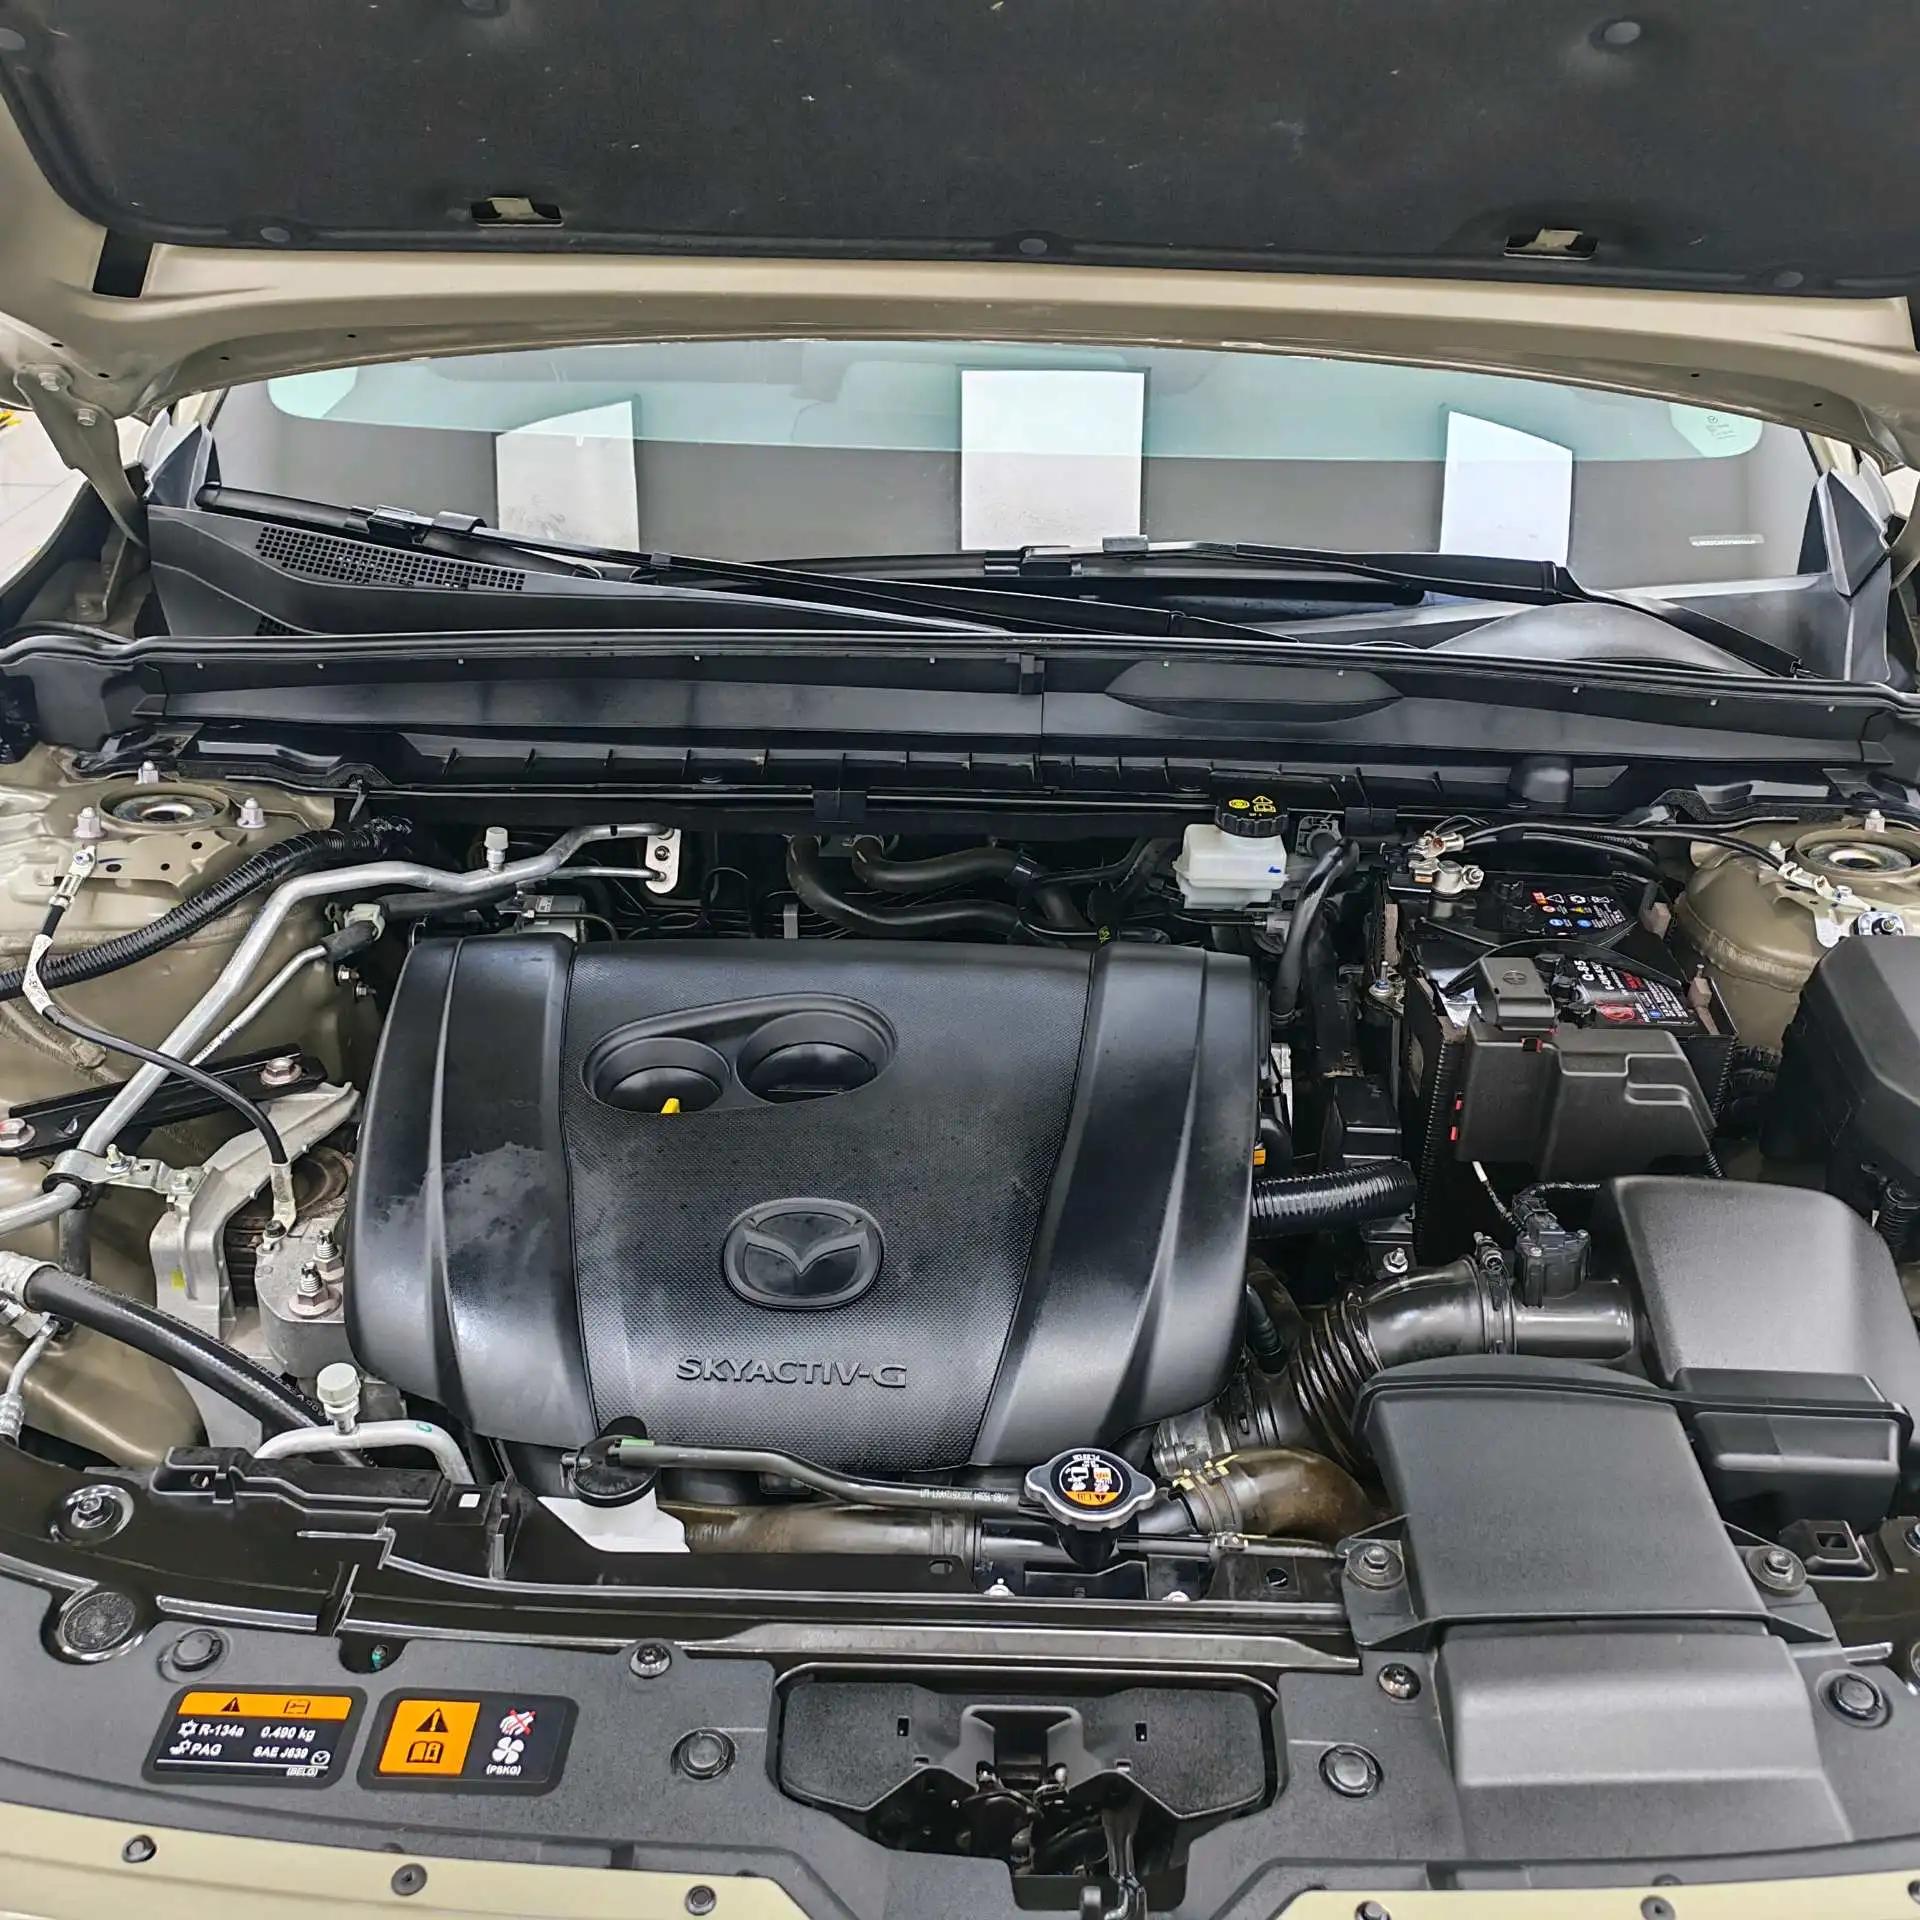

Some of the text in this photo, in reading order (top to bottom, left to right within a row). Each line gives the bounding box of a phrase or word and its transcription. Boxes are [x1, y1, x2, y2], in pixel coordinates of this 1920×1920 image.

[1574, 960, 1595, 981] Q-85
[676, 1358, 908, 1388] SKYACTIV-G
[199, 1723, 245, 1738] R-134a
[261, 1726, 316, 1743] 0.490 kg
[190, 1743, 223, 1757] PAG
[253, 1746, 309, 1760] SAE J639
